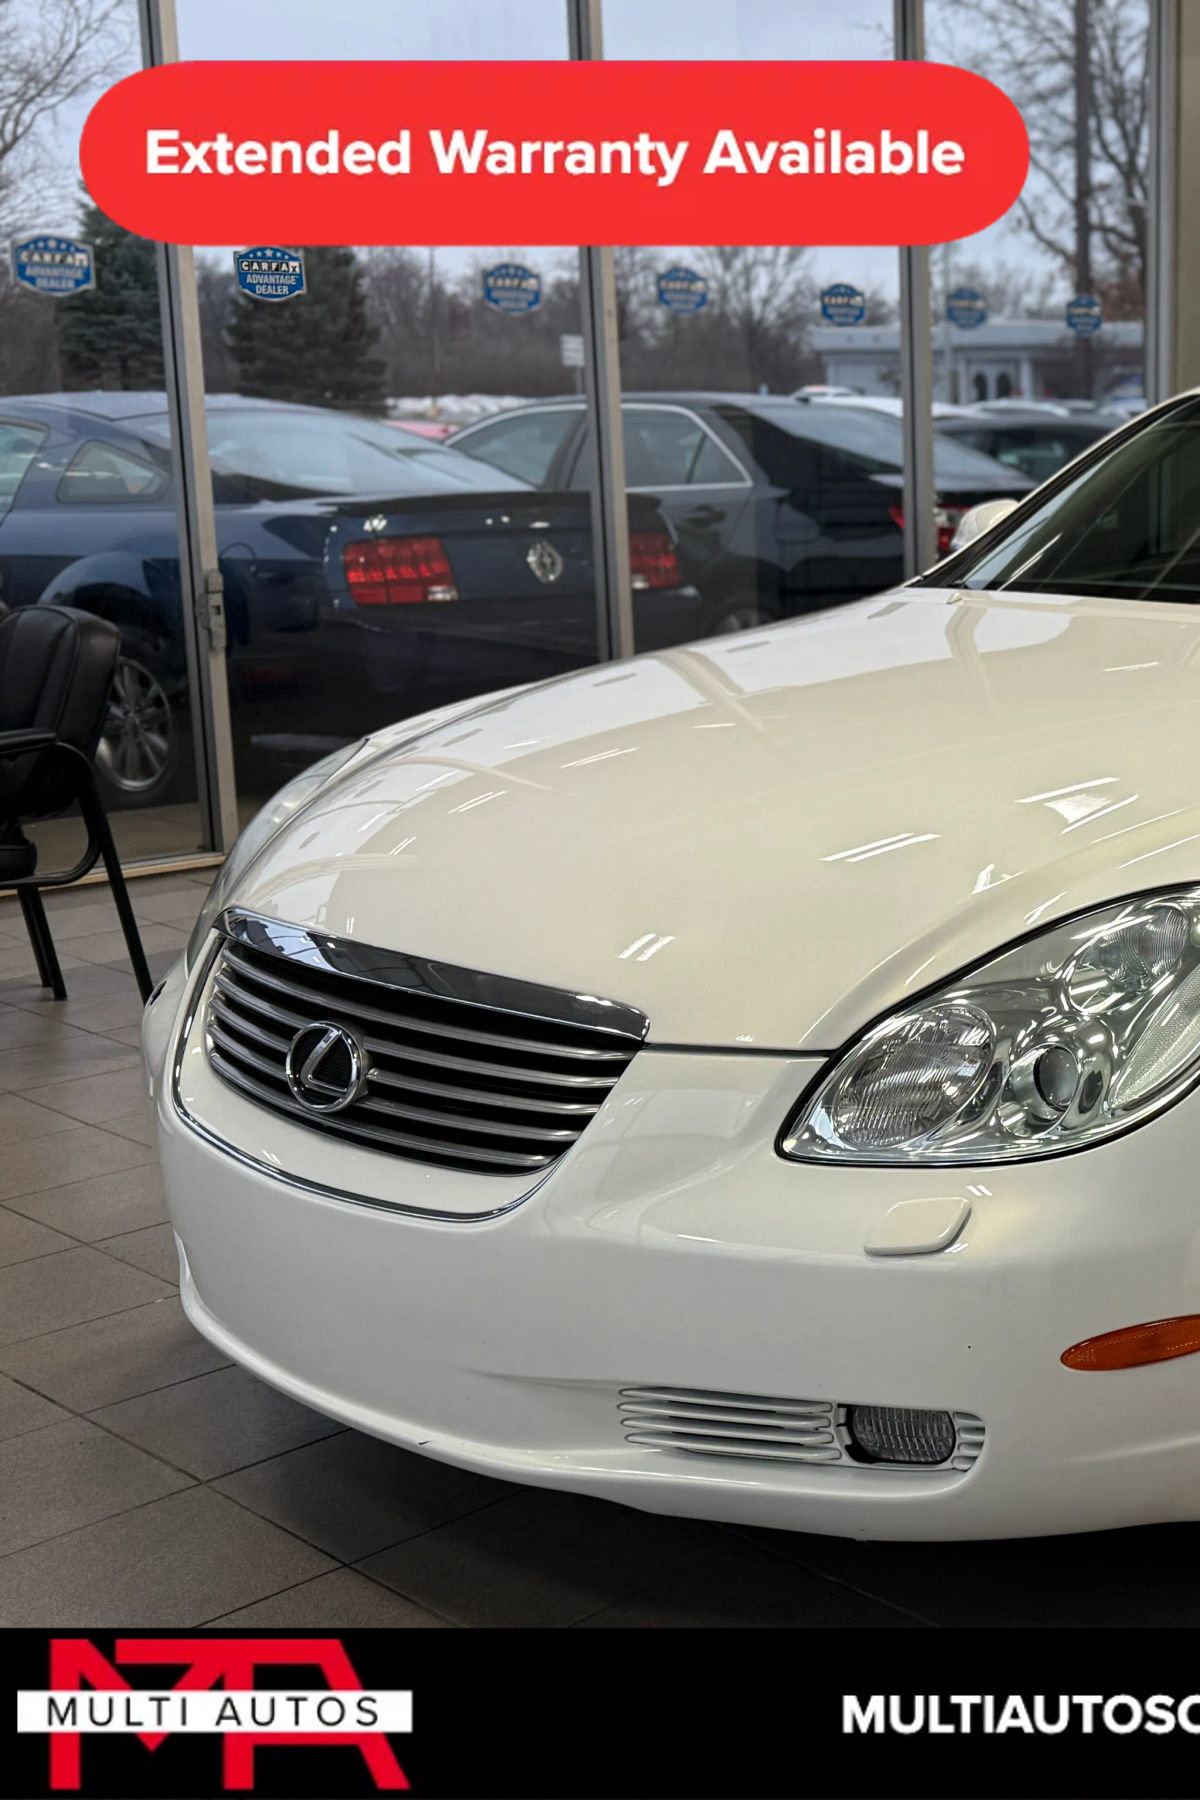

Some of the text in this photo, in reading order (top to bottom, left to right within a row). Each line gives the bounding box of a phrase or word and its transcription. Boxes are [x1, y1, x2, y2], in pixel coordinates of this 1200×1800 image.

[240, 260, 300, 273] CARFAX
[246, 273, 297, 285] ADVANTAGE
[255, 284, 289, 295] DEALER
